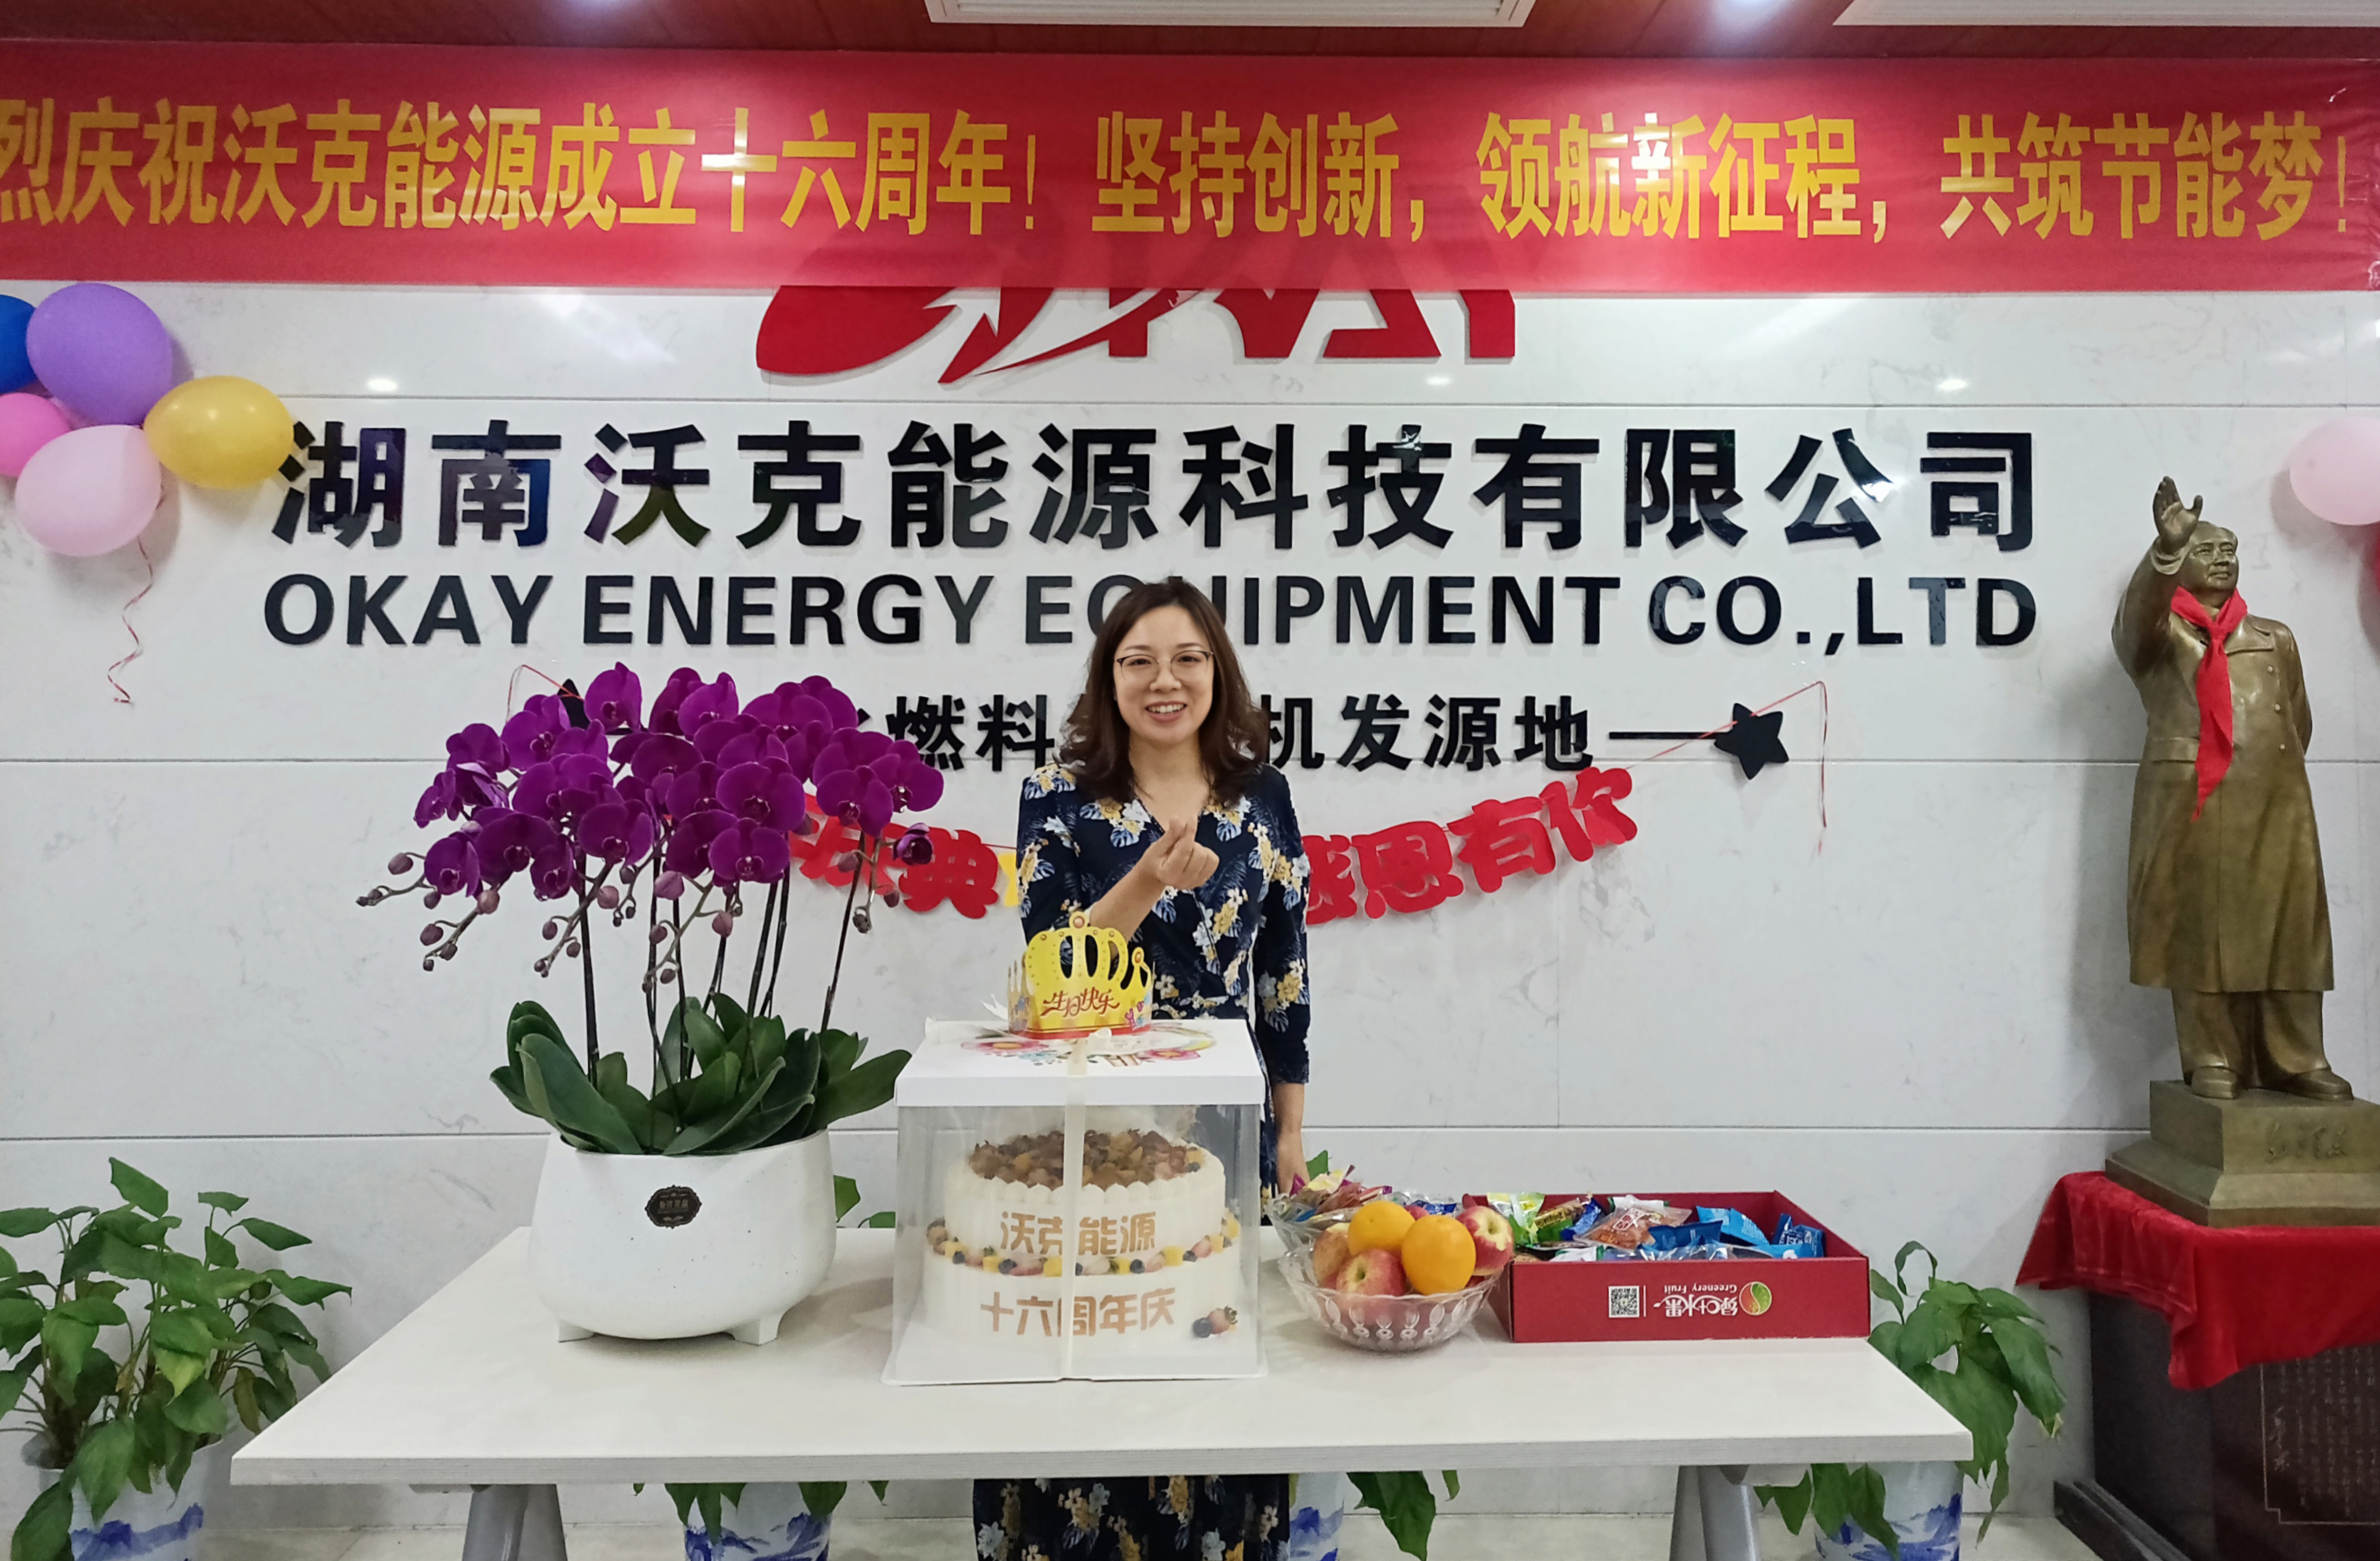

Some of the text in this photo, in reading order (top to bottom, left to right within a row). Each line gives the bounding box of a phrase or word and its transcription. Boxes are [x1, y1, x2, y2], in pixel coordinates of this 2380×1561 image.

[270, 419, 2035, 552] 湖南沃克能源科技有限公司
[263, 574, 553, 646] OKAY
[583, 574, 995, 646] ENERGY
[1040, 986, 1121, 1018] 生日快乐
[1000, 1211, 1157, 1256] 沃克能源
[1663, 1294, 1738, 1317] 绿叶水果
[1664, 1283, 1738, 1294] Greenery Fruit
[980, 1287, 1176, 1338] 十六周年庆
